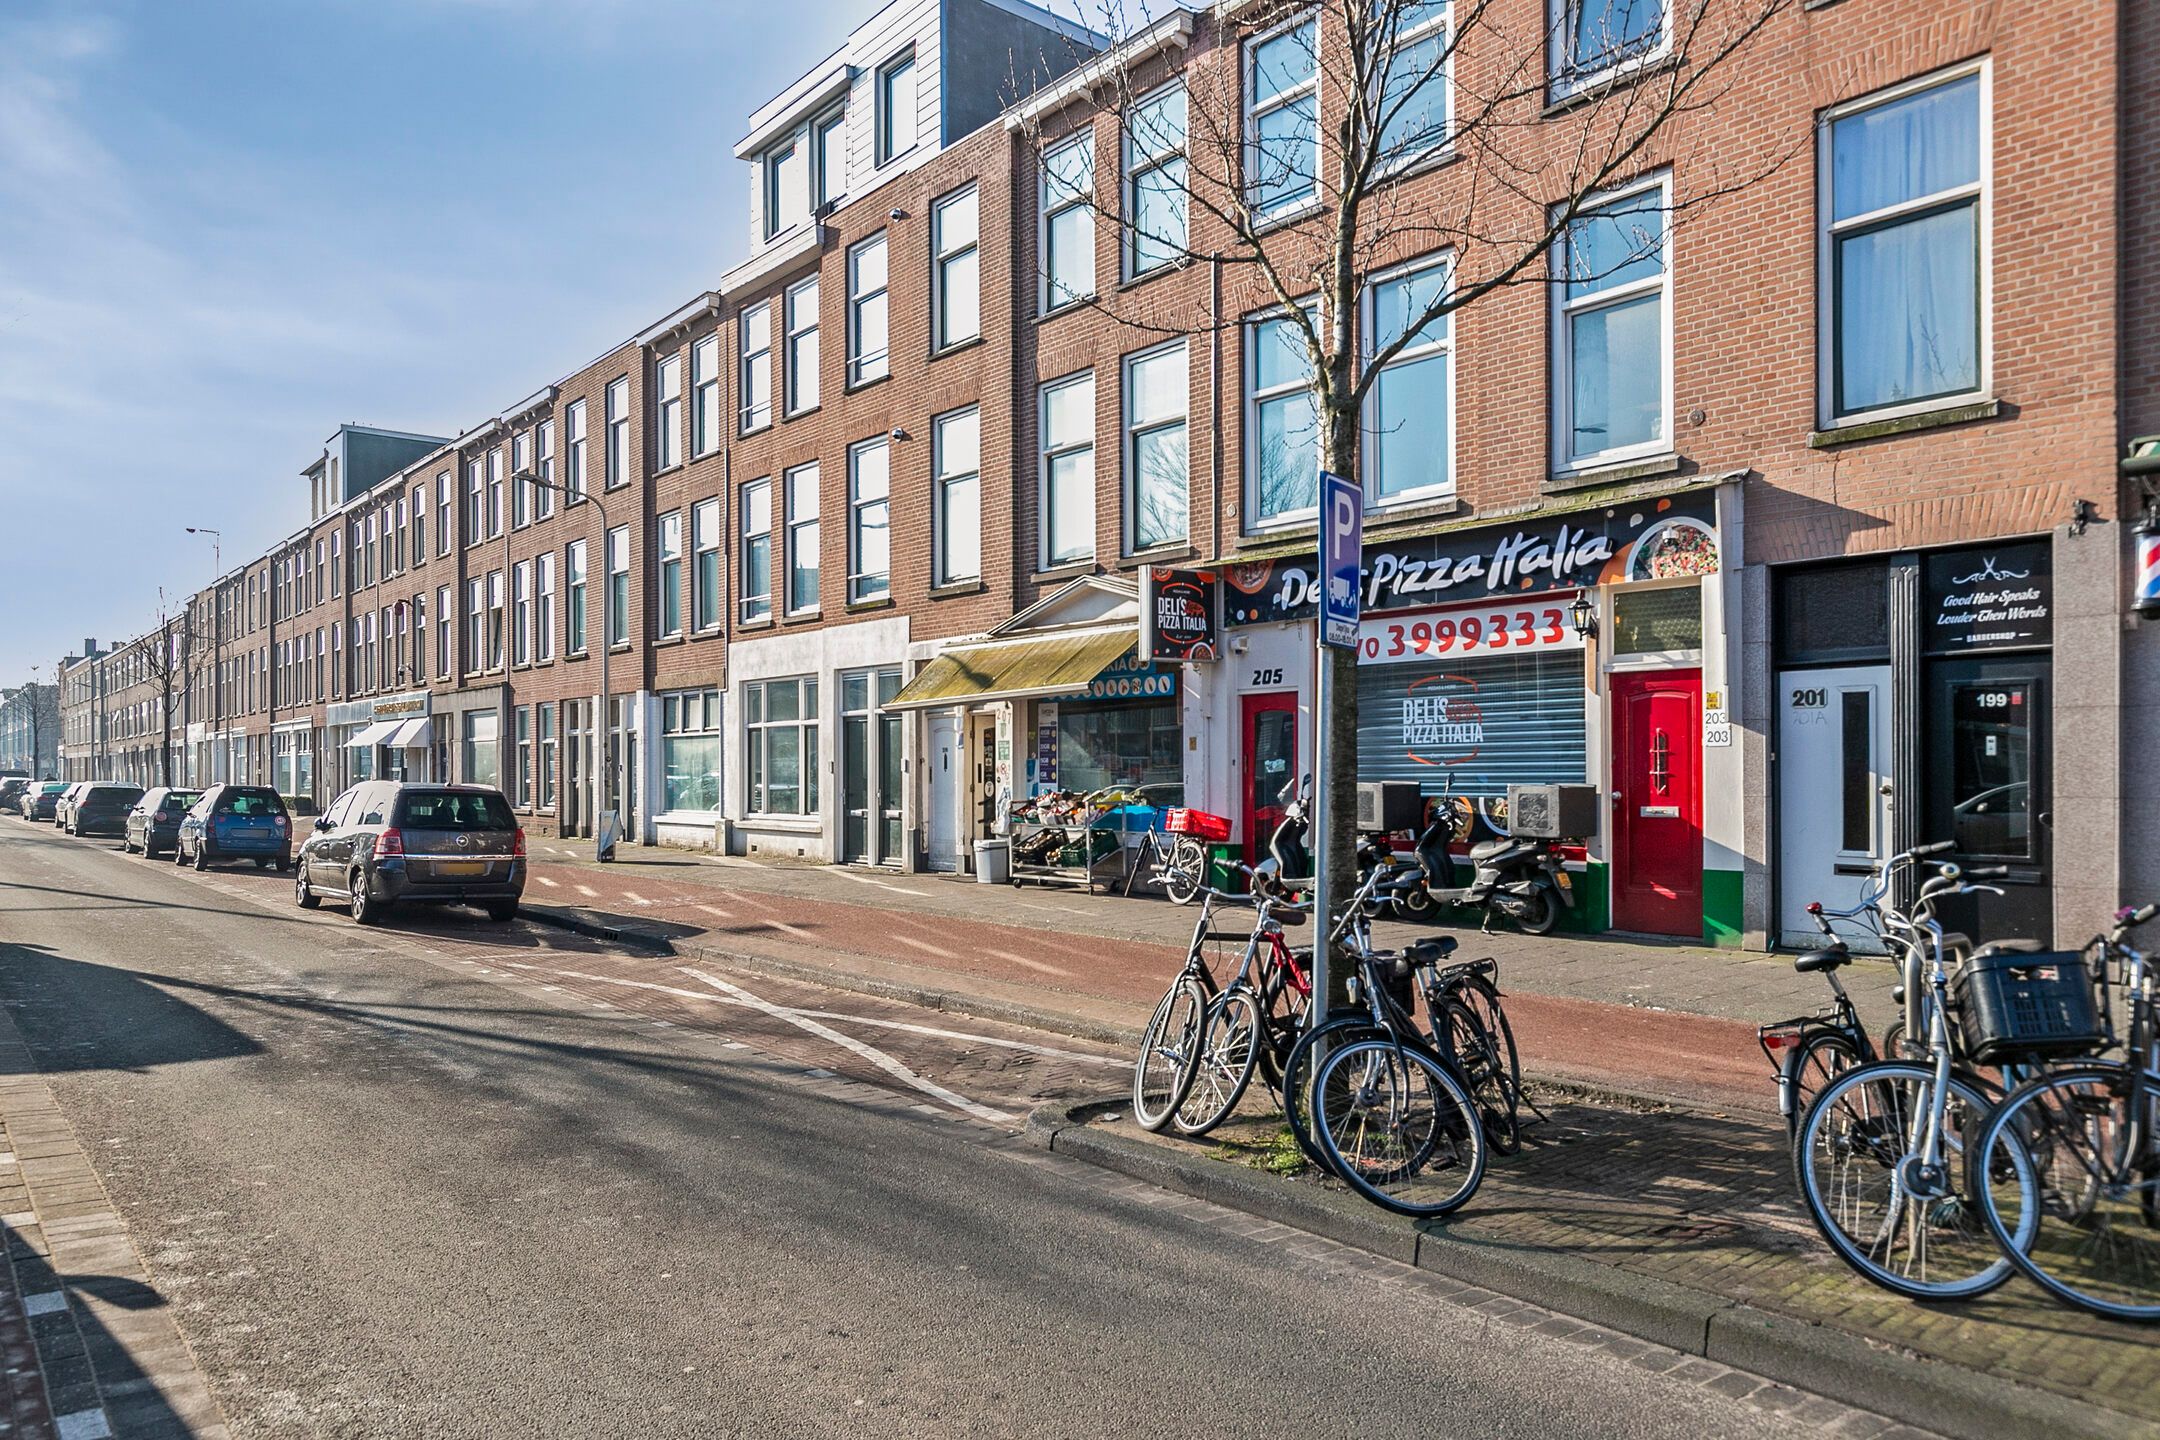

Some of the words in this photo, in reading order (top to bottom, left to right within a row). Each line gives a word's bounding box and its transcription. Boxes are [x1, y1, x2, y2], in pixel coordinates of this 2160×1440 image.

[1334, 489, 1355, 560] P
[1368, 553, 1485, 607] Pizza
[1486, 523, 1613, 591] Italia
[1157, 596, 1187, 616] DELI'S
[1943, 593, 1975, 607] Good
[1972, 592, 1999, 605] Hair
[1998, 588, 2040, 606] Speaks
[1157, 615, 1181, 630] PIZZA
[1182, 616, 1207, 632] ITALIA
[1936, 611, 1978, 625] Louder
[1977, 609, 2008, 622] Then
[2007, 605, 2048, 620] Words
[1387, 608, 1564, 657] 3999333
[1252, 668, 1283, 686] 205
[1792, 688, 1826, 708] 201
[1976, 693, 2007, 707] 199
[1402, 696, 1449, 725] DELI'S
[1705, 712, 1726, 725] 203
[1402, 724, 1440, 744] PIZZA
[1442, 723, 1484, 743] ITALIA
[1707, 730, 1729, 743] 203
